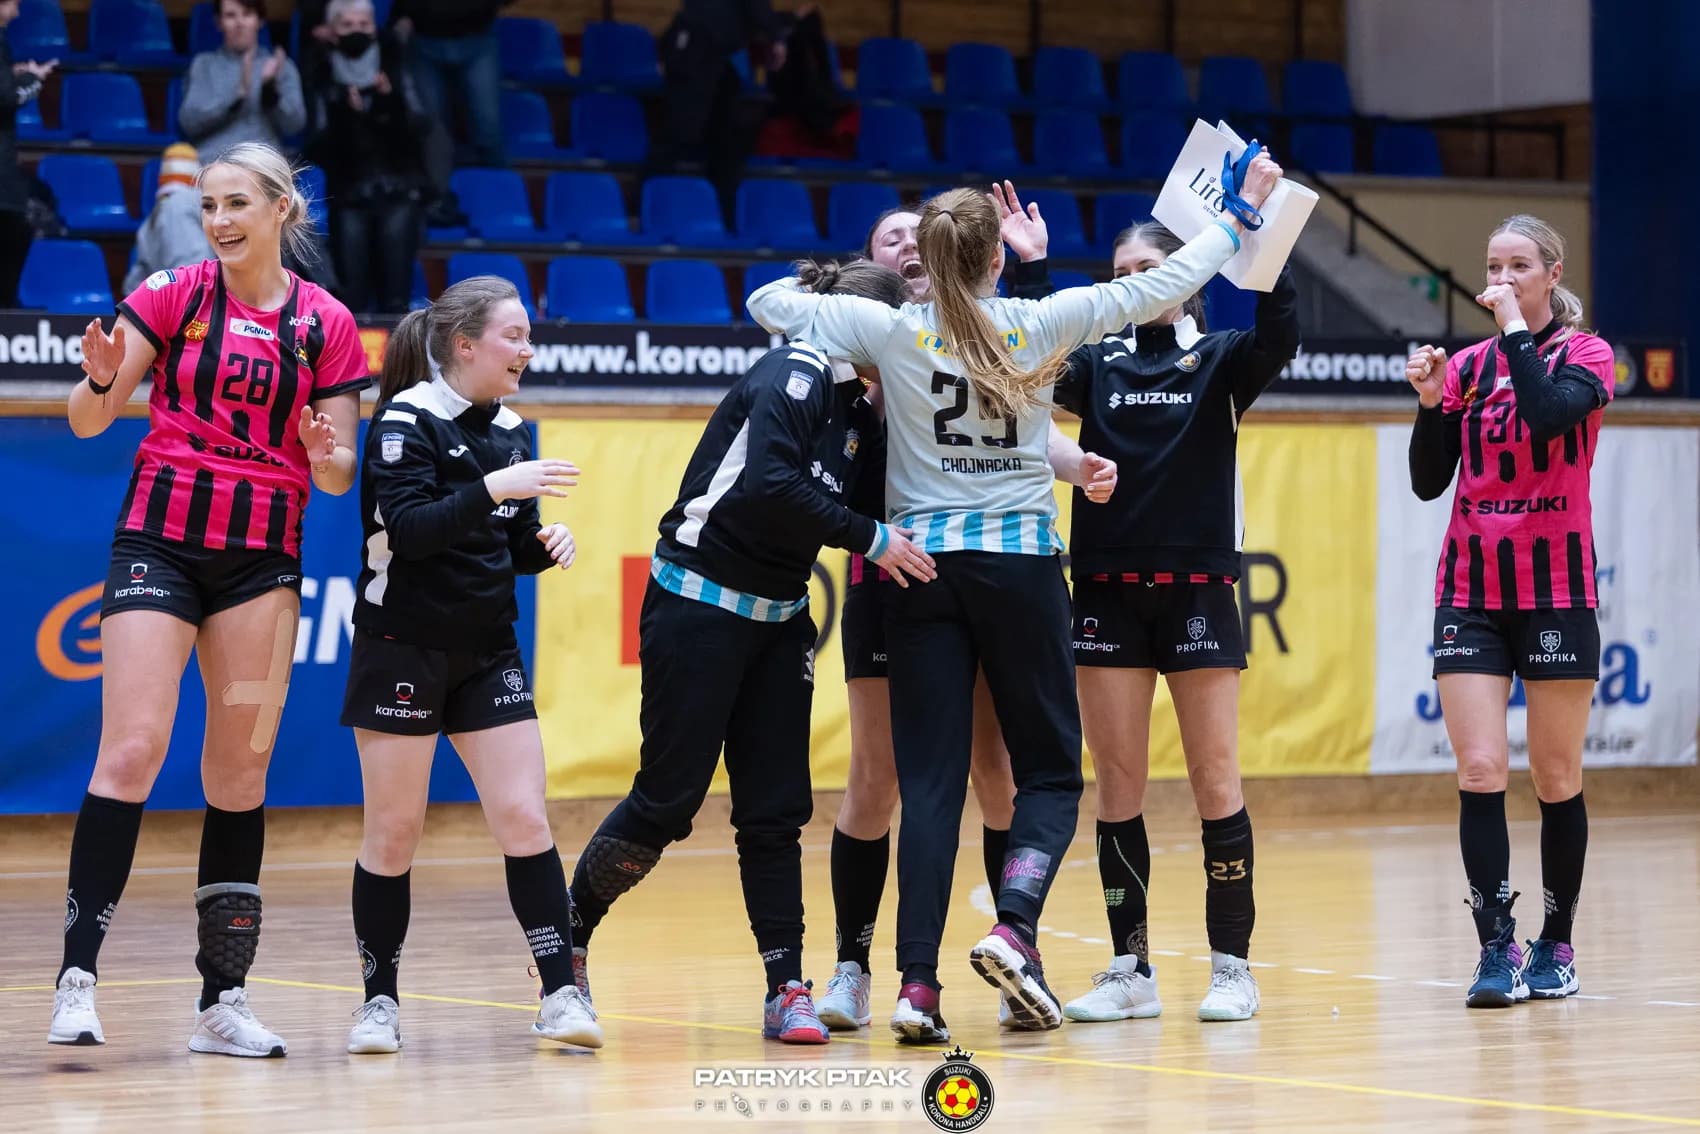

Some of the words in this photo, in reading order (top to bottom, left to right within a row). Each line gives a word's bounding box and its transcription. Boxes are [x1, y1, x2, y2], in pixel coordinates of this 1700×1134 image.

[221, 353, 275, 406] 28
[1124, 392, 1193, 405] SUZUKI
[941, 457, 1022, 474] CHOJNACKA
[1476, 496, 1567, 515] SUZUKI
[115, 585, 164, 599] karabela
[1072, 641, 1113, 652] arabela
[1176, 641, 1220, 654] PROFIKA
[1529, 653, 1577, 664] PROFIKA
[375, 704, 427, 719] karabela
[1210, 858, 1247, 881] 23
[526, 925, 555, 937] SUZUKI
[531, 939, 565, 952] ANDBALL
